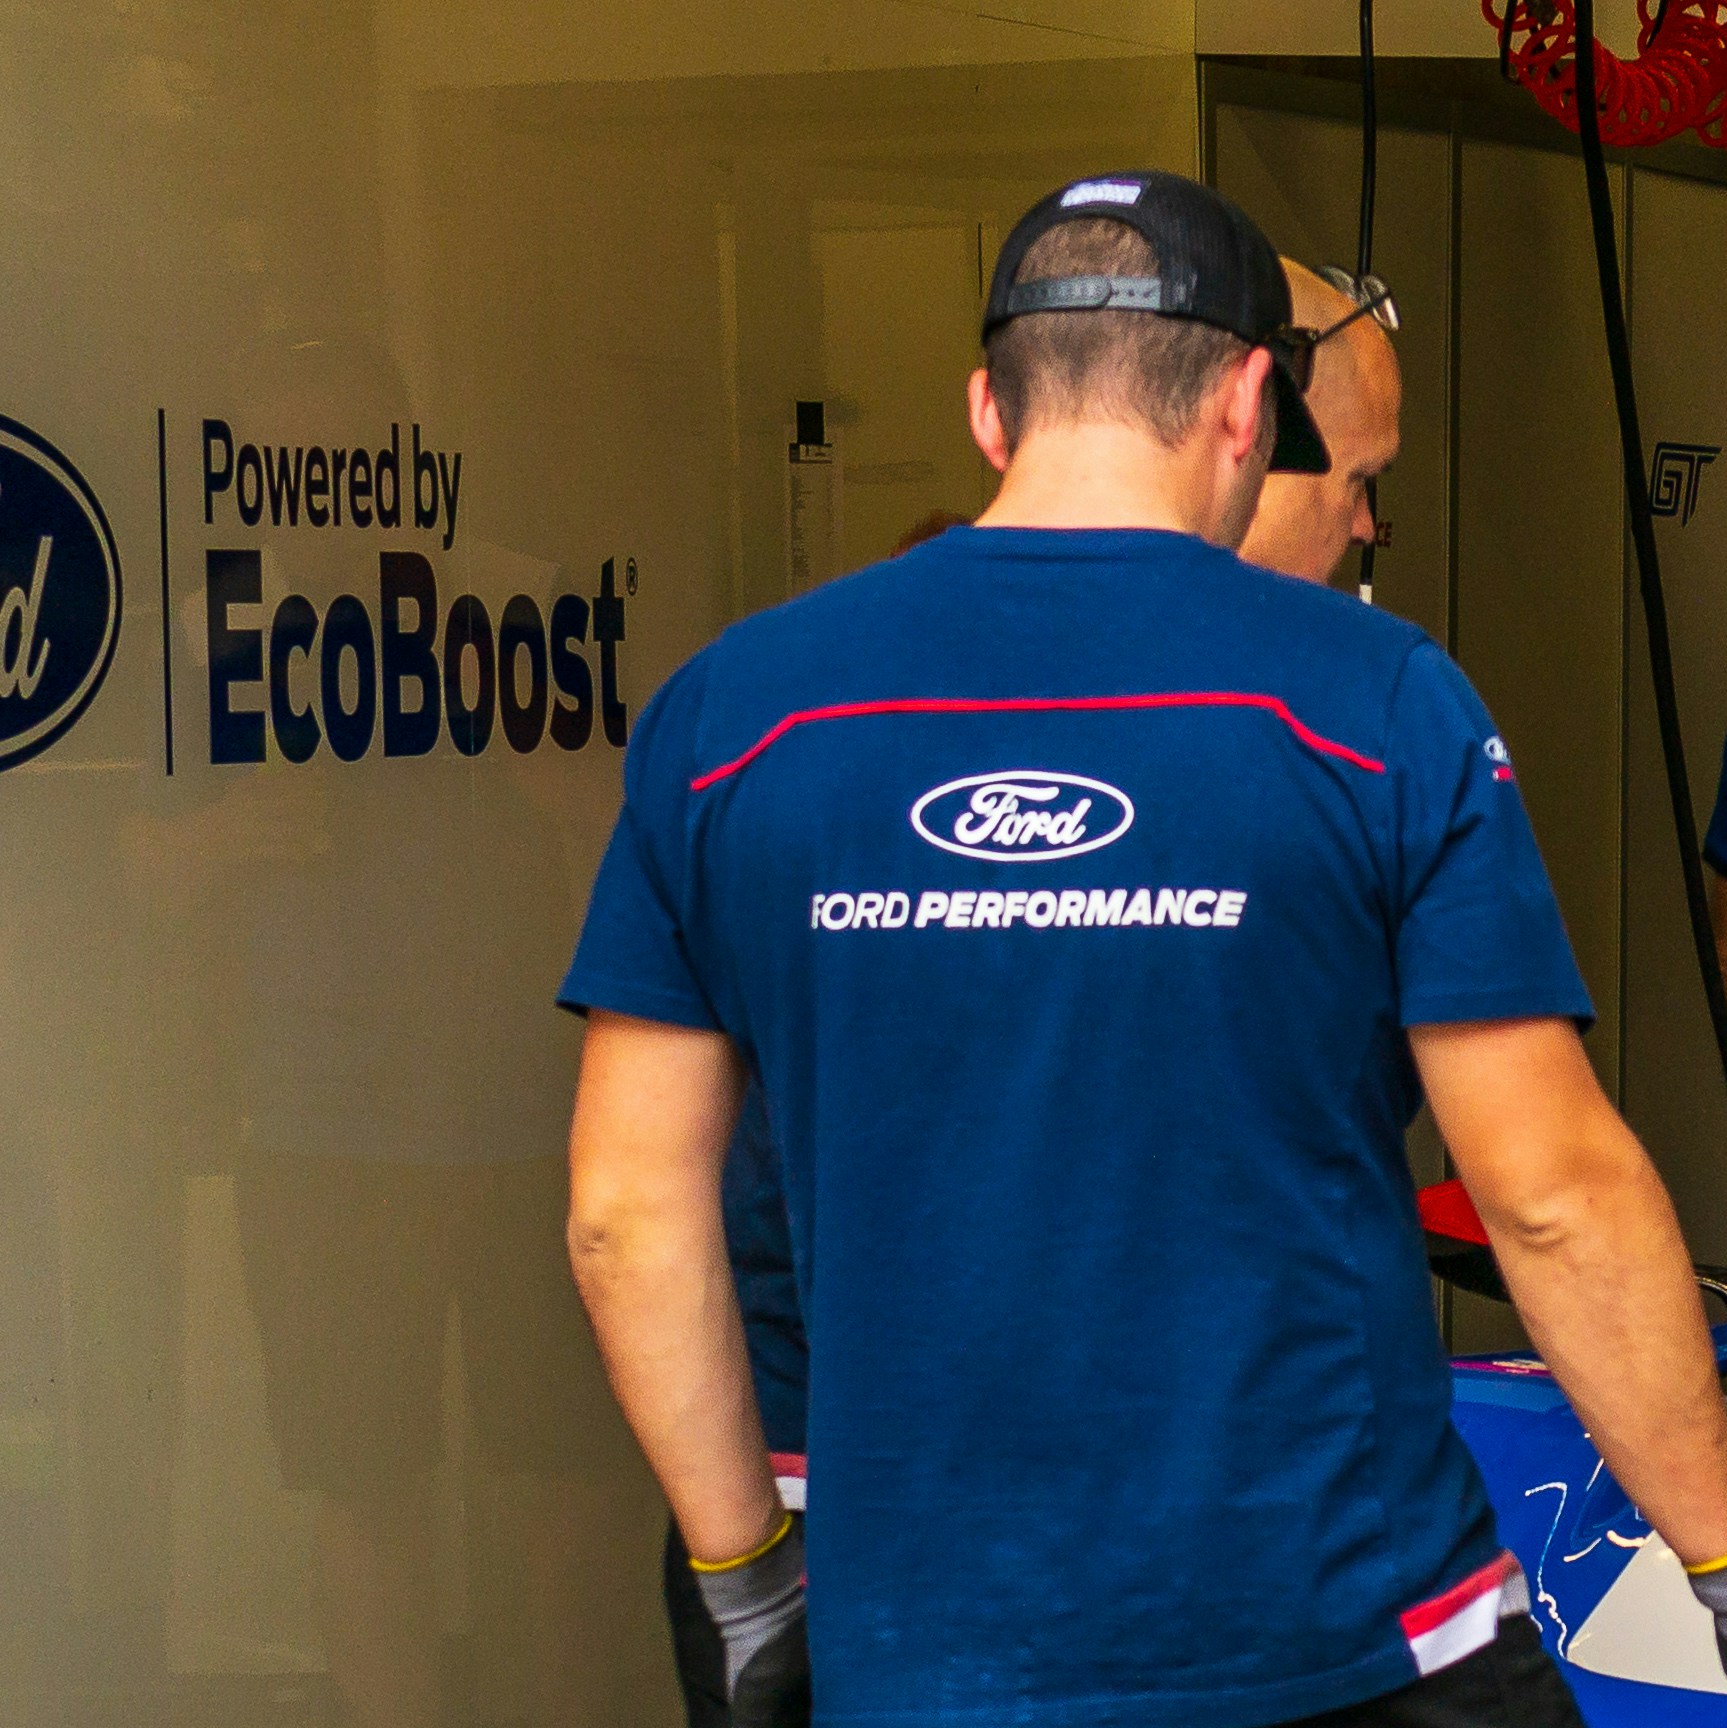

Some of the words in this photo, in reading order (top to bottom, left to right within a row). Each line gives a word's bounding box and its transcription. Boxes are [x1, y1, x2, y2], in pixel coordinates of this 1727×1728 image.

[203, 419, 400, 527] Powered
[412, 423, 462, 550] by
[954, 783, 1092, 846] Ford
[812, 891, 911, 930] FORD
[914, 889, 1247, 929] PERFORMANCE
